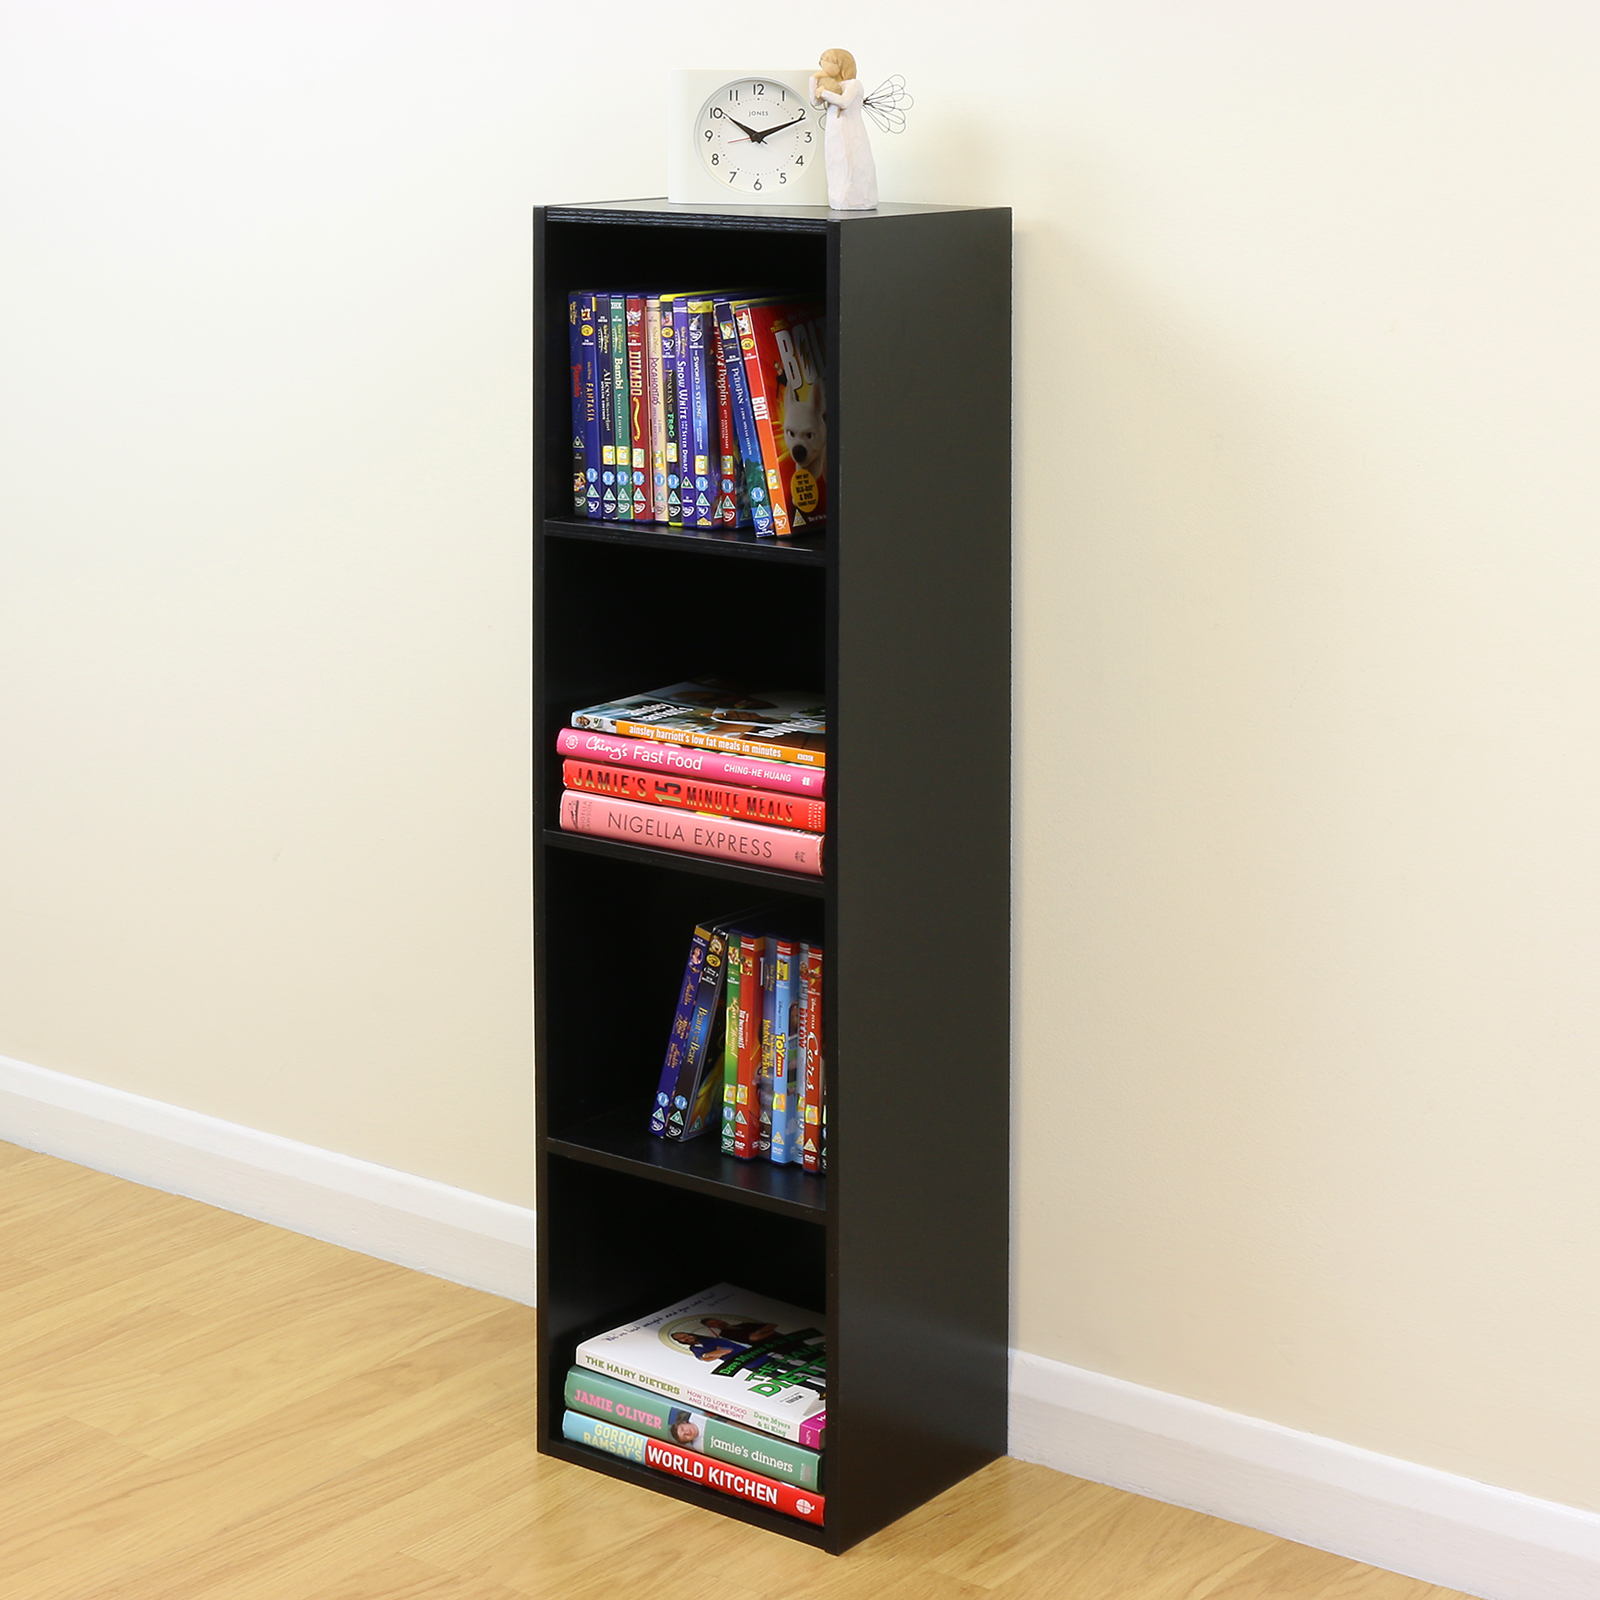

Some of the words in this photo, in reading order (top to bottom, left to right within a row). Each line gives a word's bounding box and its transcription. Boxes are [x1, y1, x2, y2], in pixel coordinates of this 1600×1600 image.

[729, 89, 739, 102] 11
[752, 83, 765, 96] 12
[781, 90, 786, 102] 1
[709, 107, 723, 119] 10
[797, 108, 807, 120] 2
[704, 130, 714, 142] 9
[804, 132, 813, 143] 3
[711, 153, 720, 166] 8
[795, 155, 805, 166] 4
[729, 171, 738, 184] 7
[753, 178, 763, 191] 6
[779, 172, 787, 184] 5
[614, 358, 624, 390] Bambi
[629, 351, 643, 396] DUMBO
[650, 358, 661, 405] POCAHONTAS
[717, 369, 728, 406] Poppins
[586, 383, 595, 422] FANTASIA
[752, 396, 769, 421] BOLT
[667, 414, 676, 438] FROG
[629, 726, 654, 740] ainsley
[656, 729, 690, 743] harriott's
[691, 735, 704, 746] low
[705, 736, 717, 748] fat
[718, 740, 741, 752] meals
[742, 743, 750, 753] in
[751, 744, 782, 758] minutes
[585, 734, 628, 761] Ching's
[633, 745, 664, 765] Fast
[667, 751, 703, 771] Food
[724, 763, 763, 778] CHING-HE
[764, 770, 792, 783] HUANG
[573, 767, 647, 797] JAMIE'S
[655, 779, 682, 803] 15
[687, 785, 740, 814] MINUTE
[746, 795, 793, 823] MEALS
[608, 812, 685, 842] NIGELLA
[694, 828, 773, 859] EXPRESS
[692, 1007, 709, 1035] Beauty
[687, 1041, 700, 1065] Beast
[776, 1033, 787, 1059] TOY
[806, 1032, 819, 1091] Cars
[585, 1355, 604, 1368] THE
[606, 1362, 637, 1380] HAIRY
[638, 1372, 681, 1395] DIETERS
[719, 1360, 741, 1375] Dave
[746, 1361, 781, 1382] THE
[574, 1389, 613, 1412] JAMIE
[618, 1402, 663, 1429] OLIVER
[687, 1389, 703, 1399] HOW
[704, 1394, 713, 1402] TO
[713, 1397, 729, 1409] LOVE
[730, 1403, 748, 1415] FOOD
[689, 1397, 702, 1406] AND
[703, 1401, 719, 1412] LOSE
[720, 1407, 745, 1420] WEIGHT
[754, 1411, 770, 1423] Dave
[771, 1417, 791, 1430] Myers
[764, 1422, 770, 1430] Si
[771, 1424, 787, 1437] King
[583, 1431, 643, 1462] RAMSAY'S
[594, 1423, 644, 1450] GORDON
[710, 1435, 749, 1458] jamie's
[751, 1445, 793, 1474] dinners
[647, 1445, 704, 1479] WORLD
[708, 1467, 778, 1505] KITCHEN
